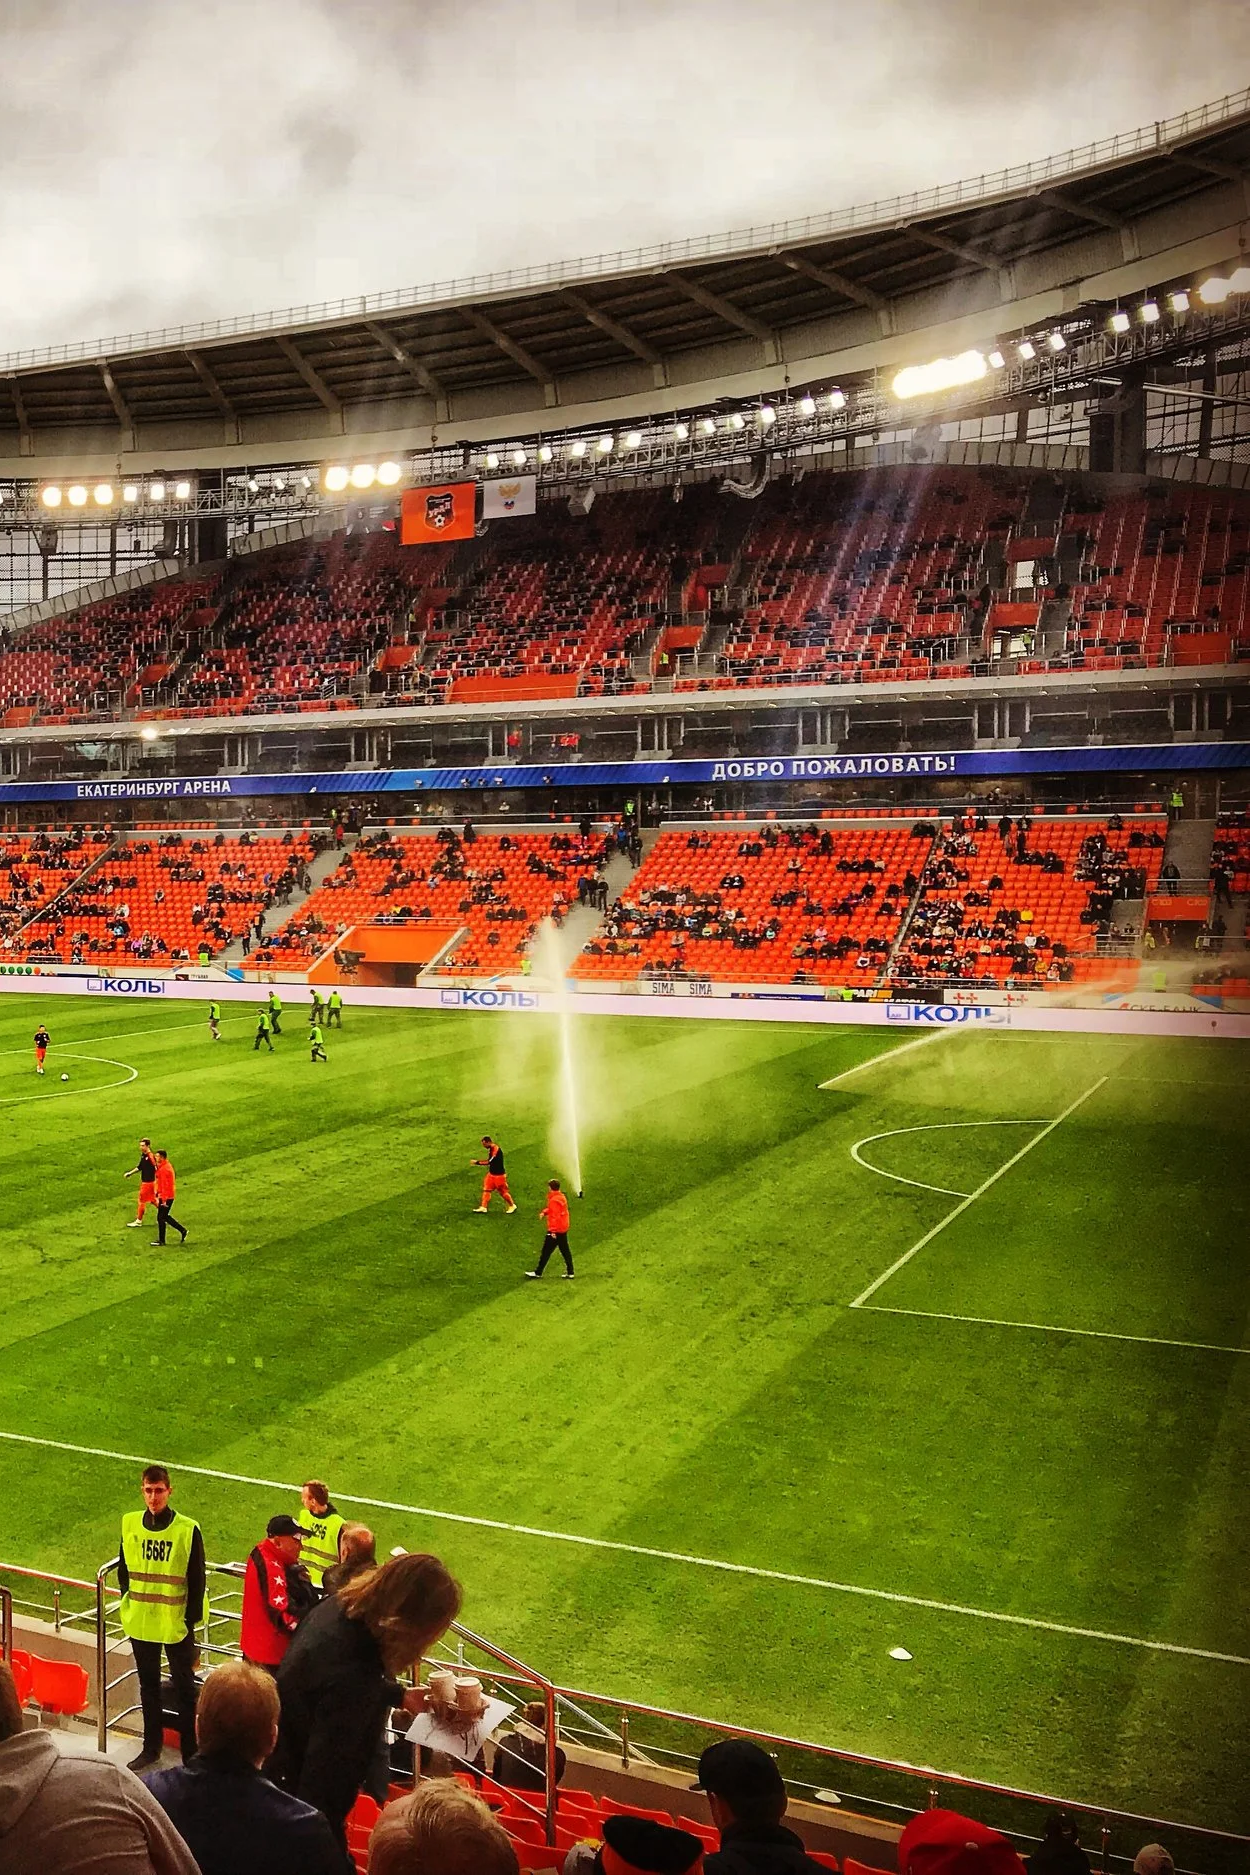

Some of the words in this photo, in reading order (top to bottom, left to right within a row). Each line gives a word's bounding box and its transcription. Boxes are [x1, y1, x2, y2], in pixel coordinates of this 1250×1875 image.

[712, 760, 784, 781] ДОБРО
[792, 756, 956, 776] ПОЖАЛОВАТЬ!
[77, 782, 180, 797] ЕКАТЕРИНБУРГ
[183, 780, 232, 794] АРЕНА
[652, 982, 675, 994] SIMA
[689, 983, 712, 995] SIMA
[141, 1538, 173, 1562] 15687
